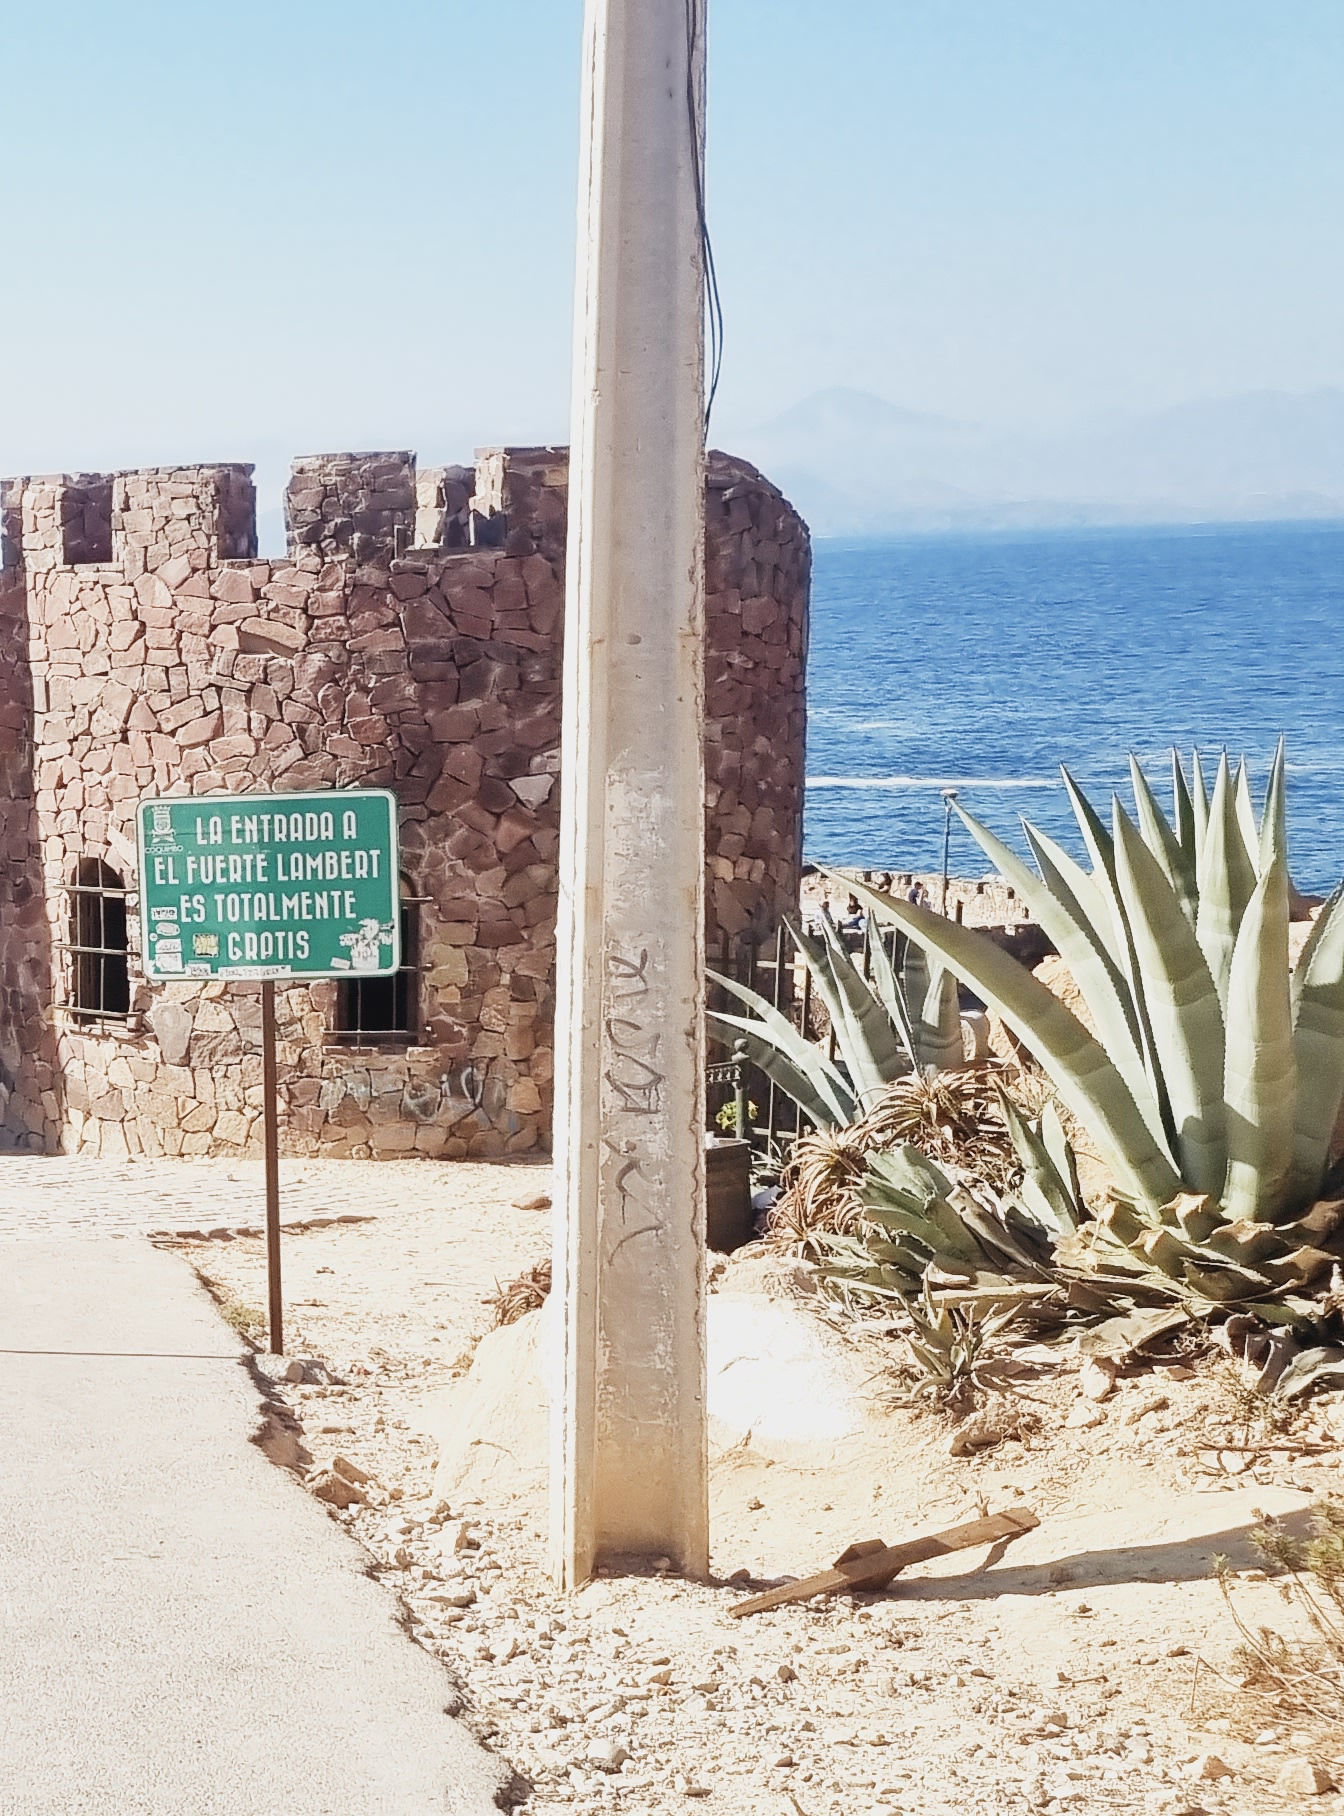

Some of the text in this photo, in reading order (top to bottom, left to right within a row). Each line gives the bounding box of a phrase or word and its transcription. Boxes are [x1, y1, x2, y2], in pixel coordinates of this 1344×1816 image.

[196, 811, 357, 845] LA ENTRADA A
[155, 850, 380, 885] EL FUERTE LAMBERT
[180, 890, 356, 923] ES TOTALMENTE
[227, 931, 310, 960] GRATIS
